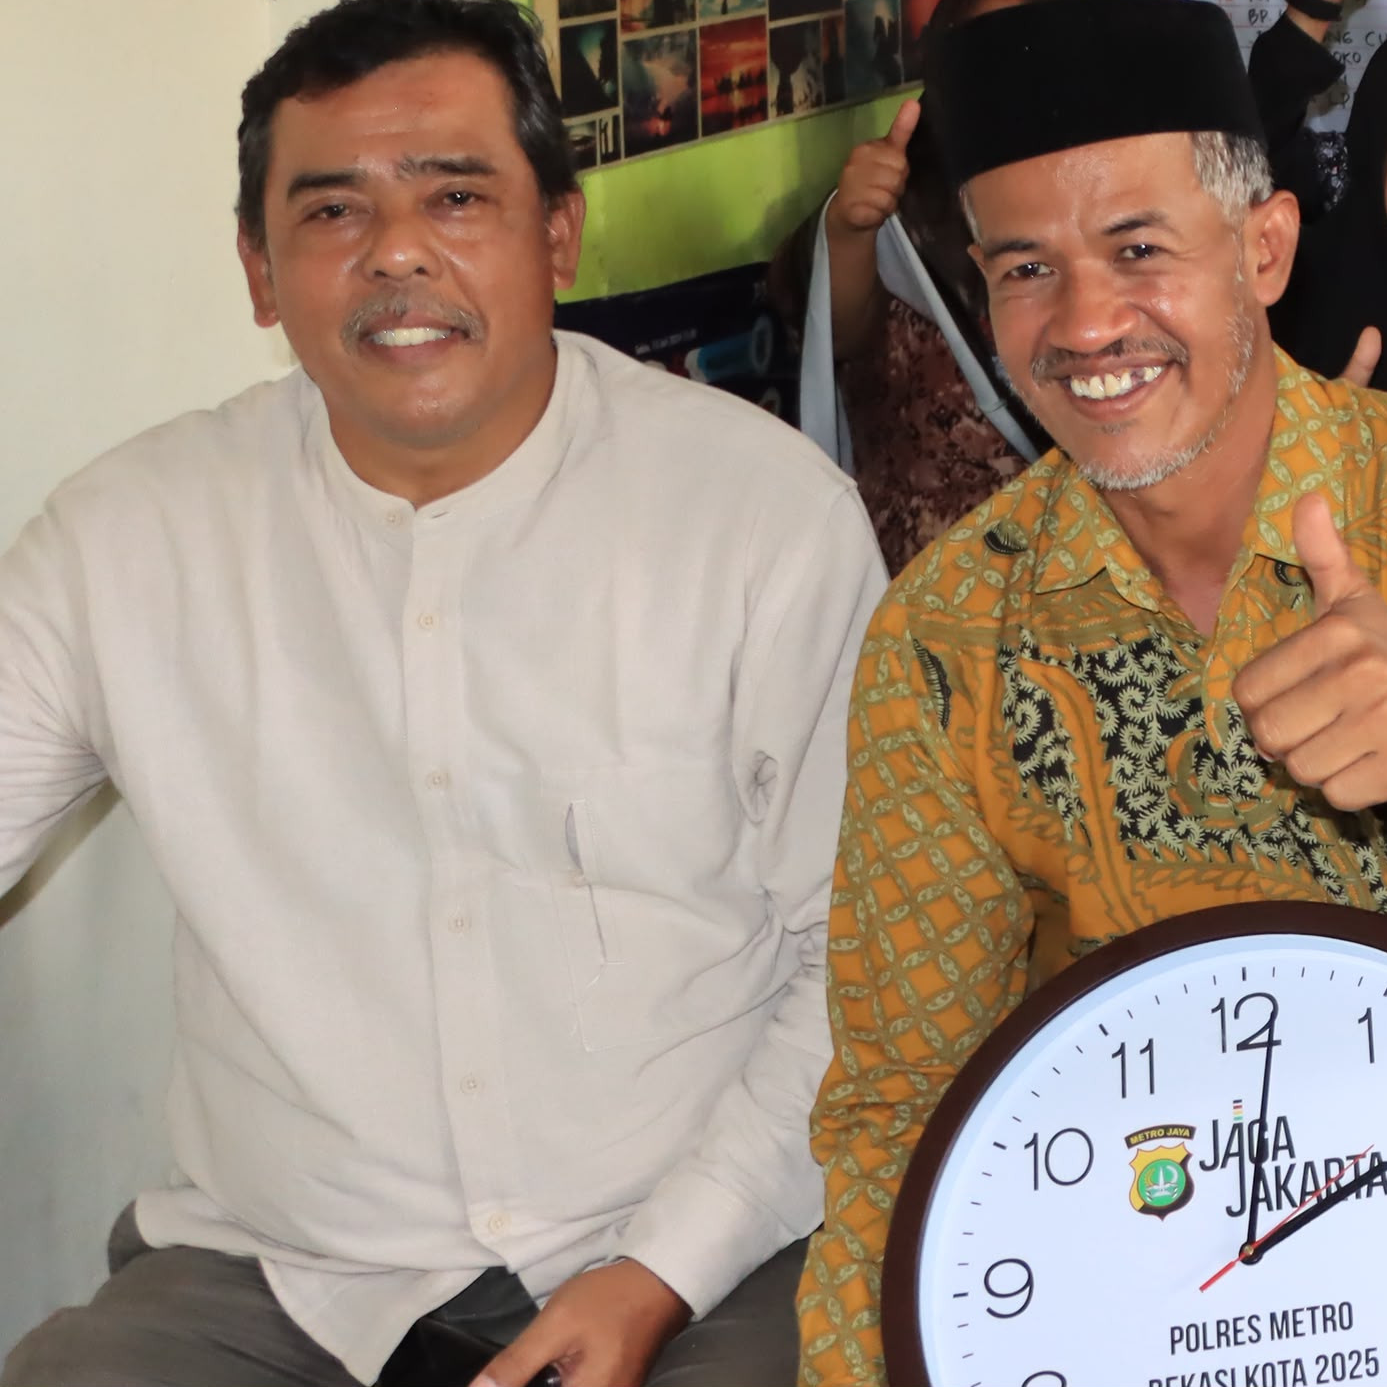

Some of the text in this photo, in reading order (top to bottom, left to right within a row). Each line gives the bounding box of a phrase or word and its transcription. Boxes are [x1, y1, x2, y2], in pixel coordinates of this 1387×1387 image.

[1208, 991, 1283, 1054] 12
[1357, 1007, 1376, 1064] 1
[1111, 1037, 1157, 1099] 11
[1023, 1126, 1094, 1191] 10
[1129, 1127, 1191, 1145] METRO JAYA
[1199, 1115, 1296, 1171] JAGA
[983, 1258, 1035, 1319] 9
[1170, 1301, 1354, 1357] POLRES METRO
[1244, 1358, 1309, 1387] KOTA
[1315, 1347, 1380, 1385] 2025
